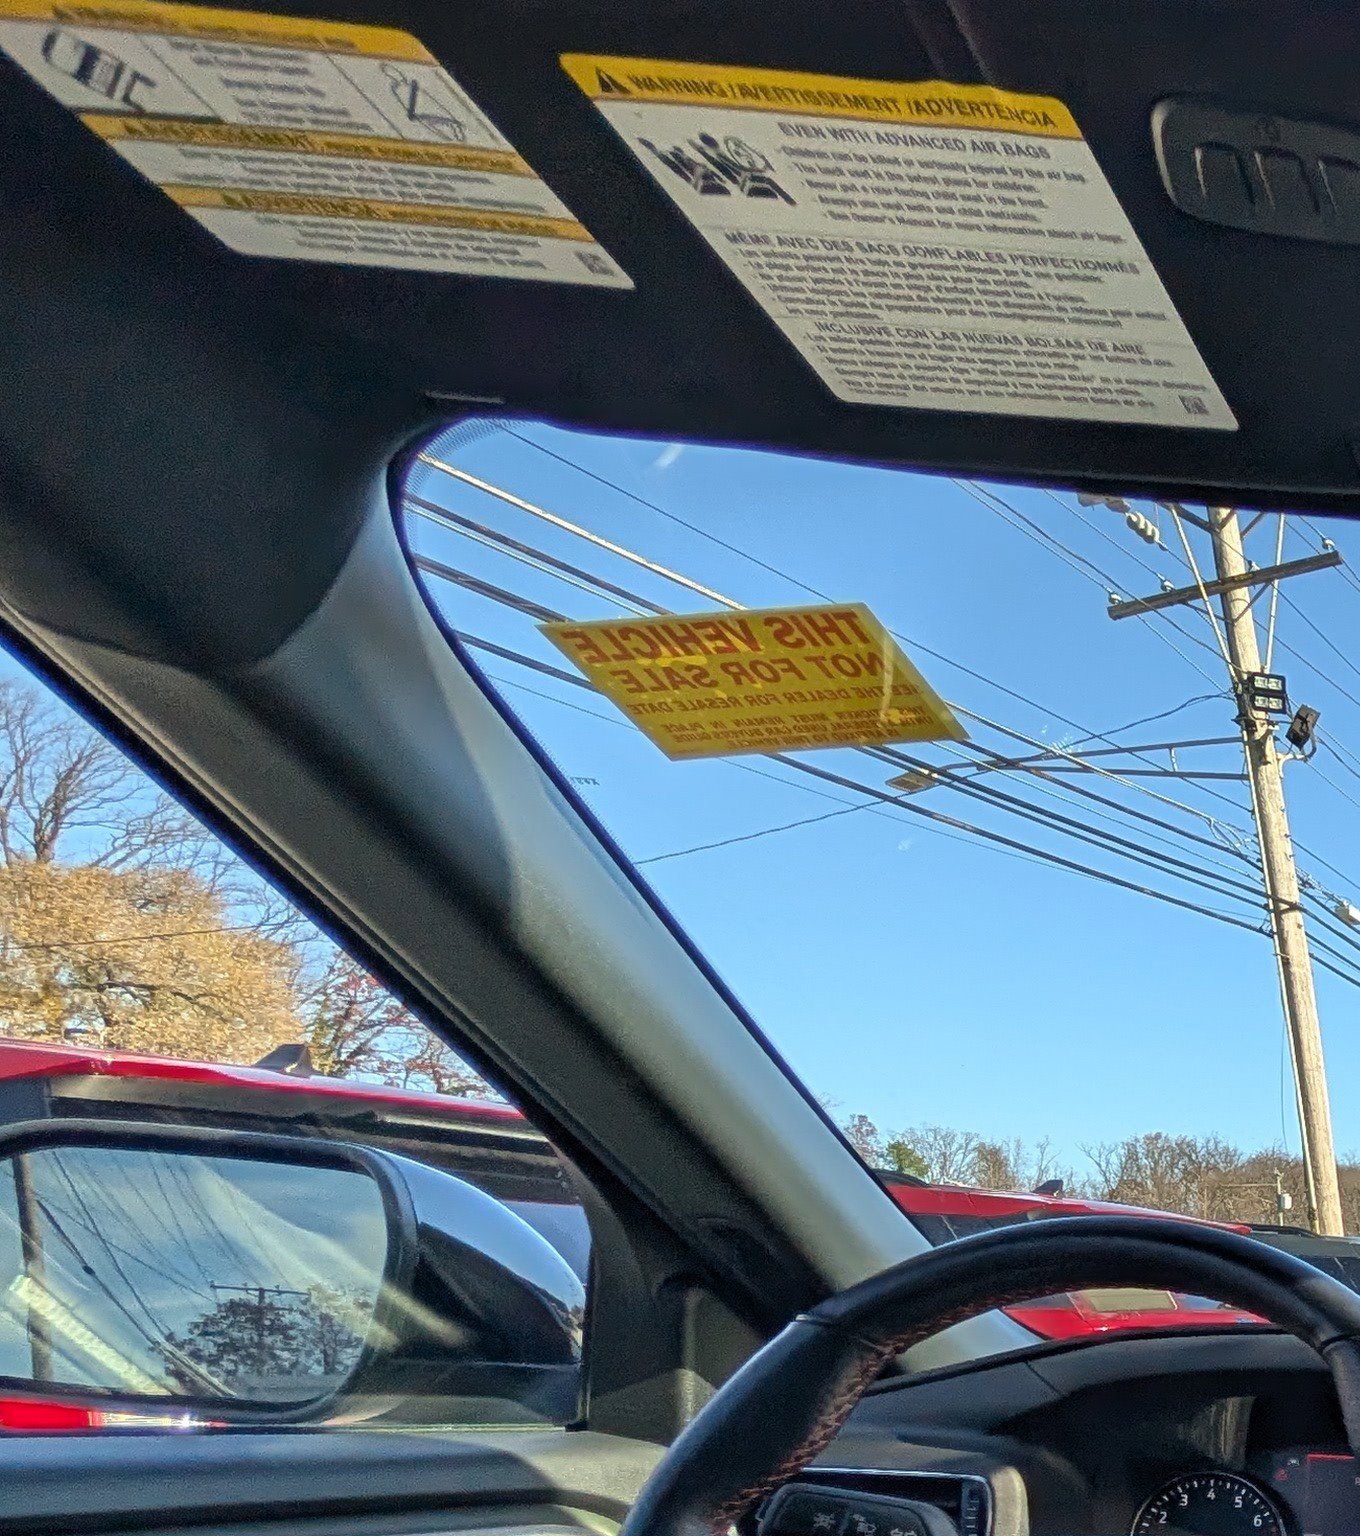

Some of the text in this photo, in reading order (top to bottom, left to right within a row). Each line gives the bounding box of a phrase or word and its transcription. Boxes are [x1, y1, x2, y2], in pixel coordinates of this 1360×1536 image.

[626, 74, 727, 100] WARNING
[778, 121, 1051, 160] EVEN WITH ADVANCED AIR BAGS
[895, 326, 930, 340] CON
[1180, 1494, 1188, 1506] 3
[1207, 1488, 1216, 1500] 4
[1234, 1496, 1242, 1508] 5
[1159, 1511, 1167, 1524] 2
[1253, 1515, 1262, 1527] 6
